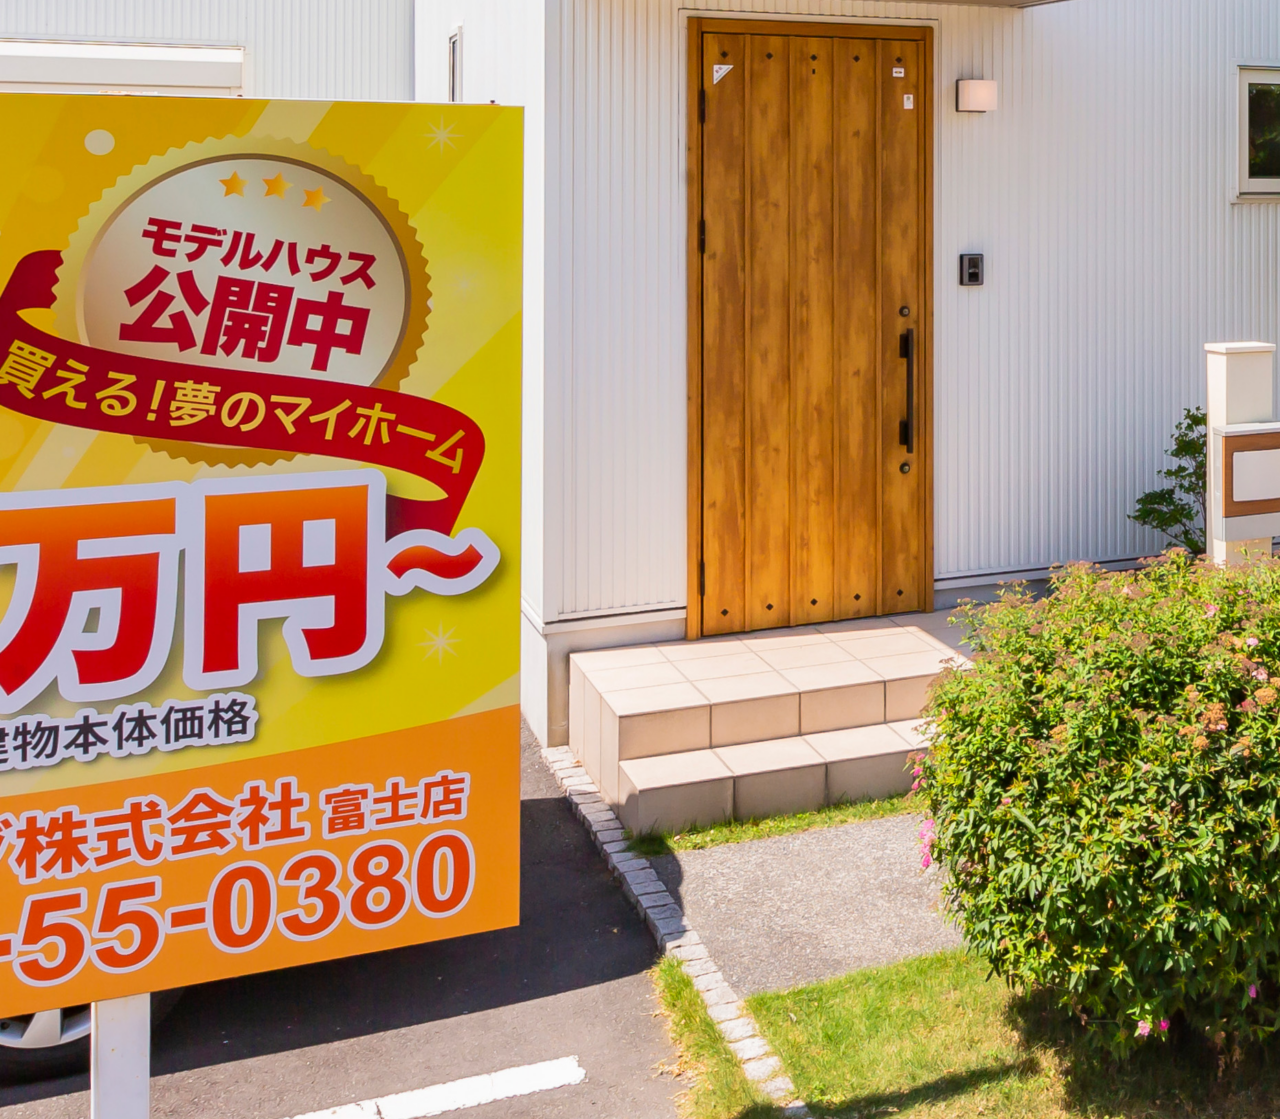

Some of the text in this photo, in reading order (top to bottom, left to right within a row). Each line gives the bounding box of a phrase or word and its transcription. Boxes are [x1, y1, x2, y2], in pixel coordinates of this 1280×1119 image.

[141, 217, 377, 290] モデルハウス
[118, 264, 371, 372] 公開中
[323, 774, 467, 835] 富士店
